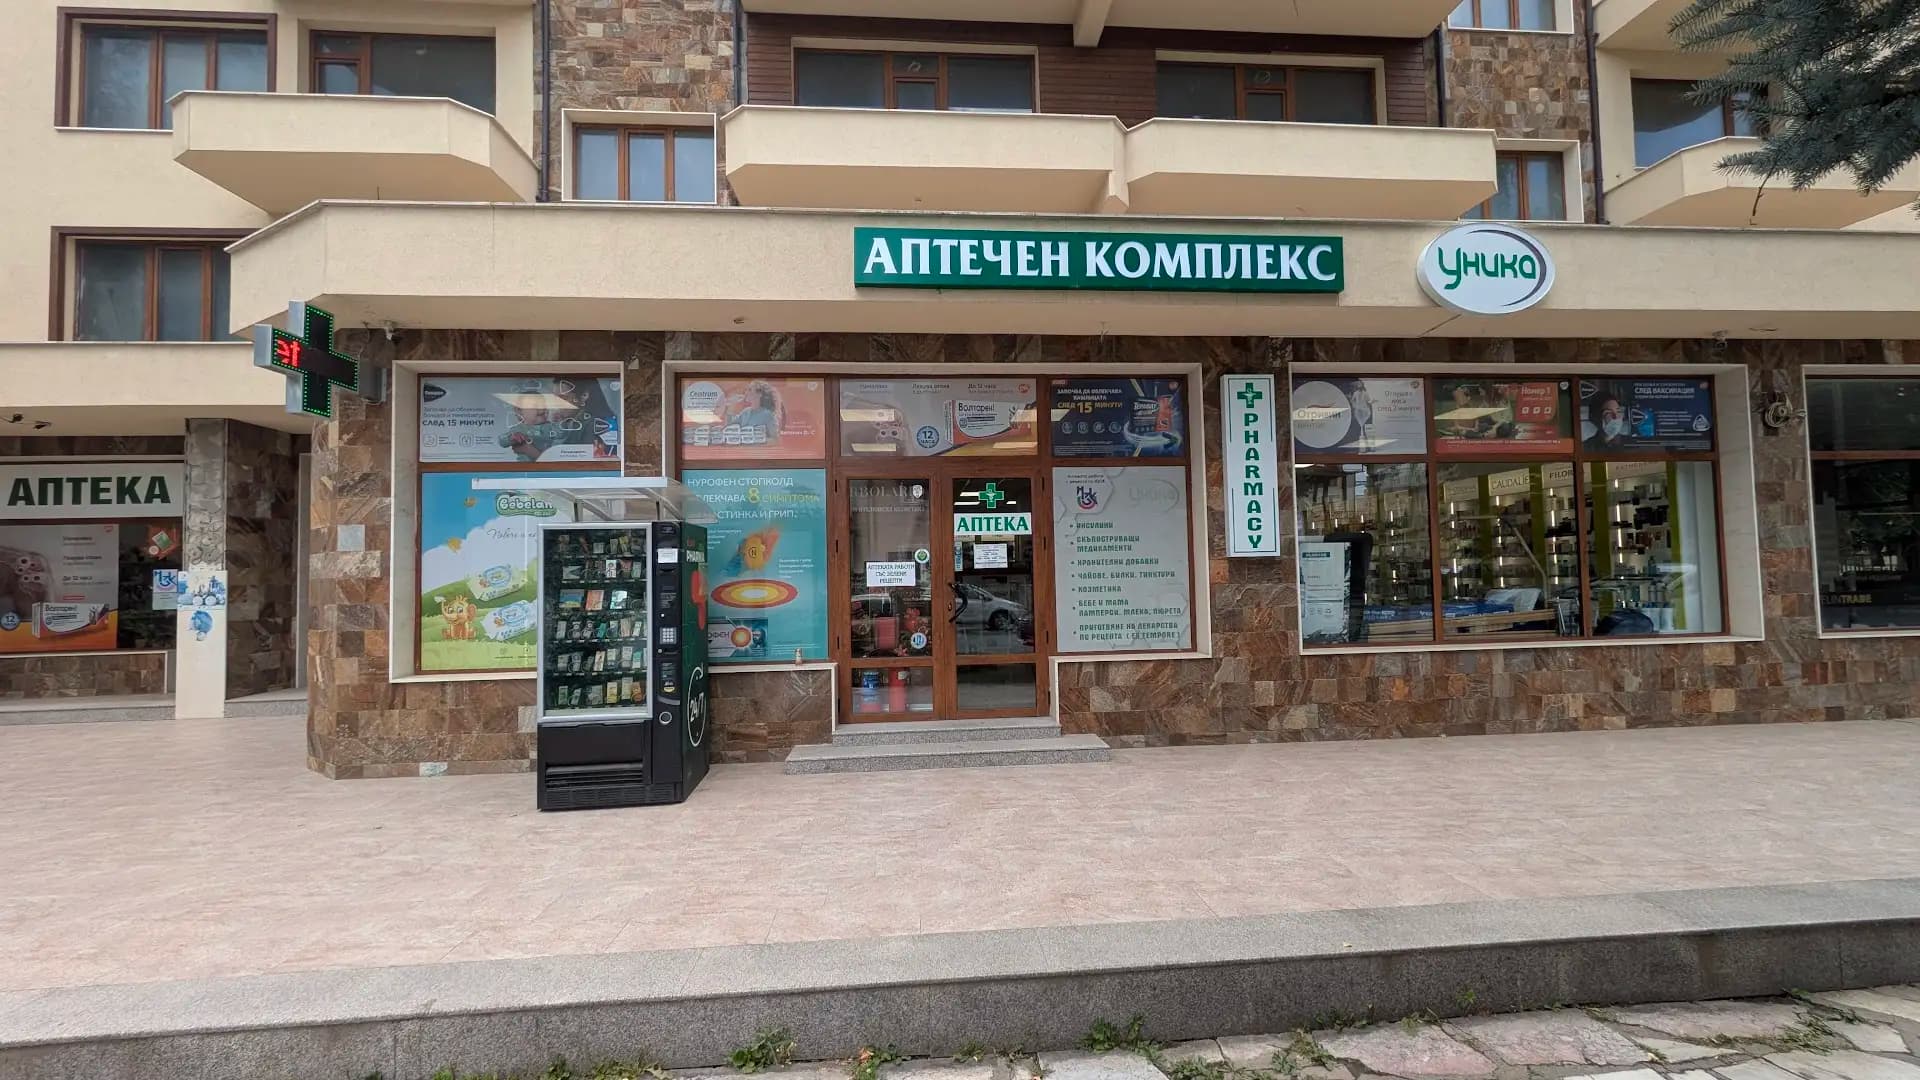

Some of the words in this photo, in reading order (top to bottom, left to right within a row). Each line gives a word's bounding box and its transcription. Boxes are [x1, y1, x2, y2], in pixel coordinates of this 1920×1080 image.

[862, 236, 1069, 277] АПТЕЧЕН
[1085, 239, 1337, 282] КОМПЛЕКС
[1077, 401, 1094, 414] 15
[922, 431, 934, 440] 12
[687, 478, 737, 488] НУРОФЕН
[738, 477, 794, 487] СТОПКОЛД
[1243, 412, 1264, 549] PHARMACY
[8, 475, 171, 506] АПТЕКА
[695, 494, 746, 503] ЛЕКЧАВА
[748, 488, 760, 504] 8
[957, 516, 1029, 532] АПТЕКА
